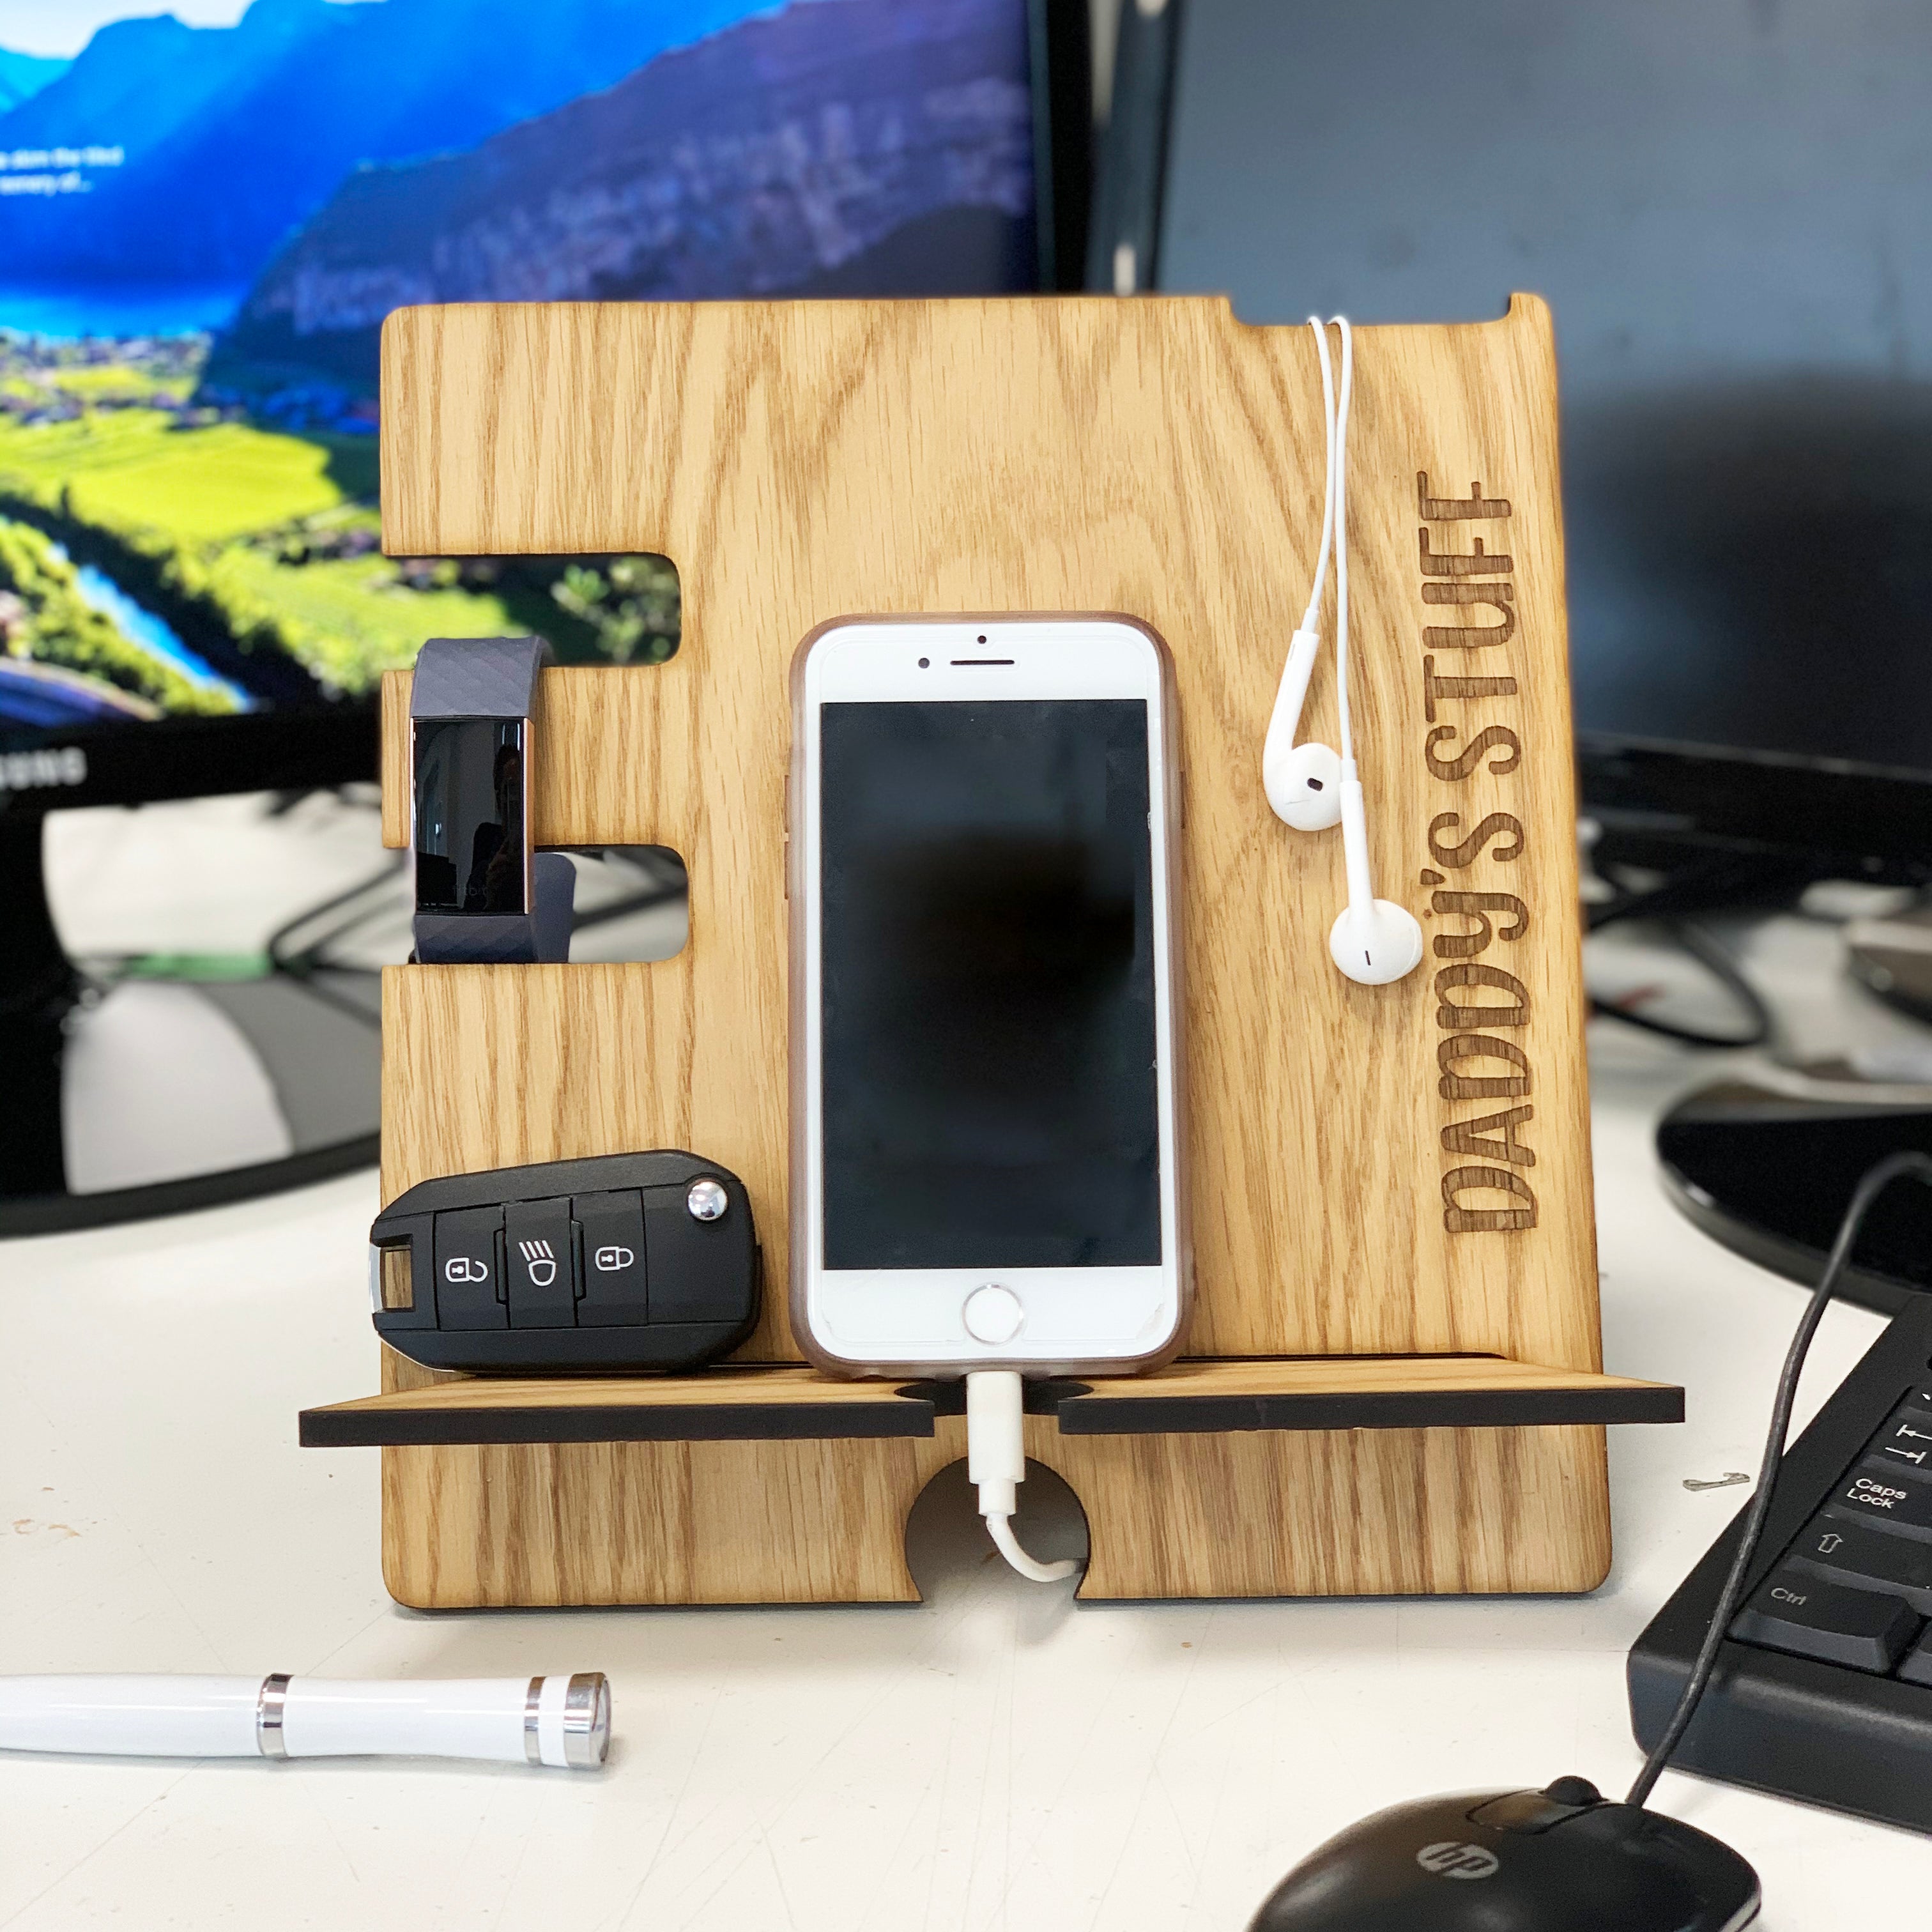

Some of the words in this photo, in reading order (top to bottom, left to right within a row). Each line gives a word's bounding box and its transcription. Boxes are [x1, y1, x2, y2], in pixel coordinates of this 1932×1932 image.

[1416, 470, 1522, 782] STUFF
[1846, 1487, 1894, 1509] Lock
[1855, 1478, 1908, 1499] Caps
[1770, 1588, 1807, 1606] Ctrl
[1419, 1842, 1498, 1878] hp
